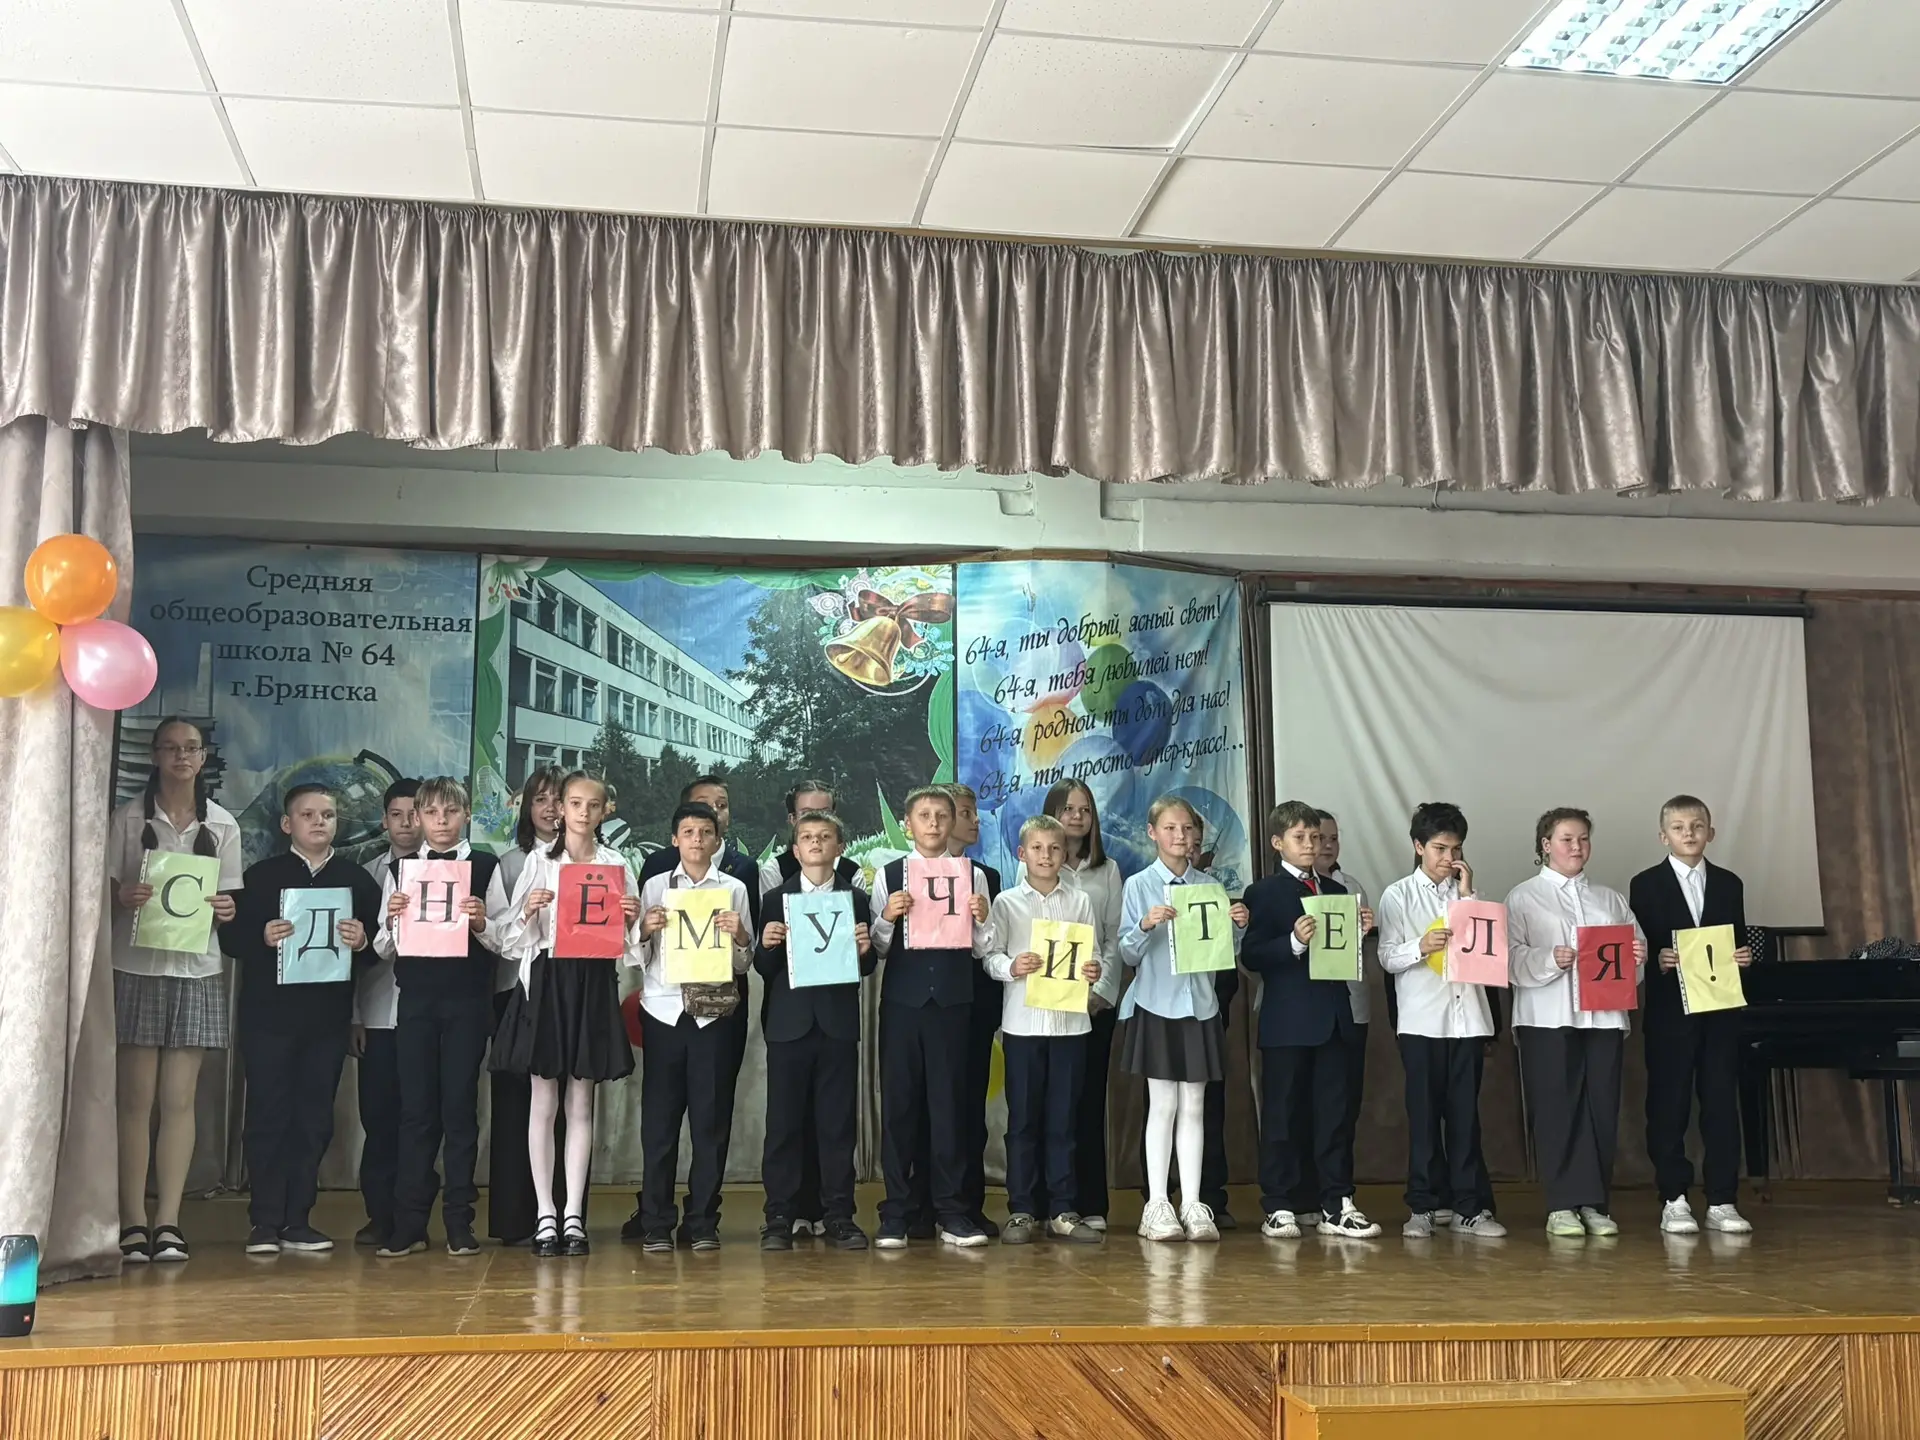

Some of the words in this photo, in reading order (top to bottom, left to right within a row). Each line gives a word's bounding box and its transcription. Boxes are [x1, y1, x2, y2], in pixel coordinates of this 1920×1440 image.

[246, 565, 374, 595] Средняя
[150, 599, 473, 634] общеобразовательная
[965, 636, 1009, 665] 64-я,
[1019, 632, 1049, 652] ты
[1057, 612, 1121, 648] добрый,
[1129, 611, 1175, 631] ясный
[1180, 595, 1221, 623] свет!
[217, 643, 311, 663] школа
[321, 641, 352, 664] №
[361, 643, 396, 666] 64
[994, 675, 1039, 704] 64-я,
[1048, 660, 1095, 692] тебя
[1093, 651, 1170, 694] любимей
[1175, 640, 1210, 671] нет!
[230, 675, 378, 705] г.Брянска
[980, 723, 1025, 753] 64-я,
[1033, 710, 1096, 751] родной
[1103, 708, 1128, 727] ты
[1135, 696, 1166, 722] дом
[1171, 689, 1195, 725] для
[1200, 680, 1230, 711] нас!
[979, 770, 1023, 799] 64-я,
[1033, 766, 1064, 788] ты
[1072, 755, 1134, 782] просто
[1138, 726, 1243, 776] упер-класс!...
[161, 873, 203, 918] С
[416, 880, 458, 923] Н
[575, 873, 609, 926] Ё
[923, 875, 960, 916] Ч
[297, 907, 340, 961] Д
[674, 908, 730, 951] М
[1187, 901, 1219, 941] Т
[1320, 911, 1348, 950] Е
[1460, 915, 1498, 957] Л
[1040, 938, 1084, 981] И
[1590, 942, 1627, 982] Я
[1704, 943, 1717, 982] !
